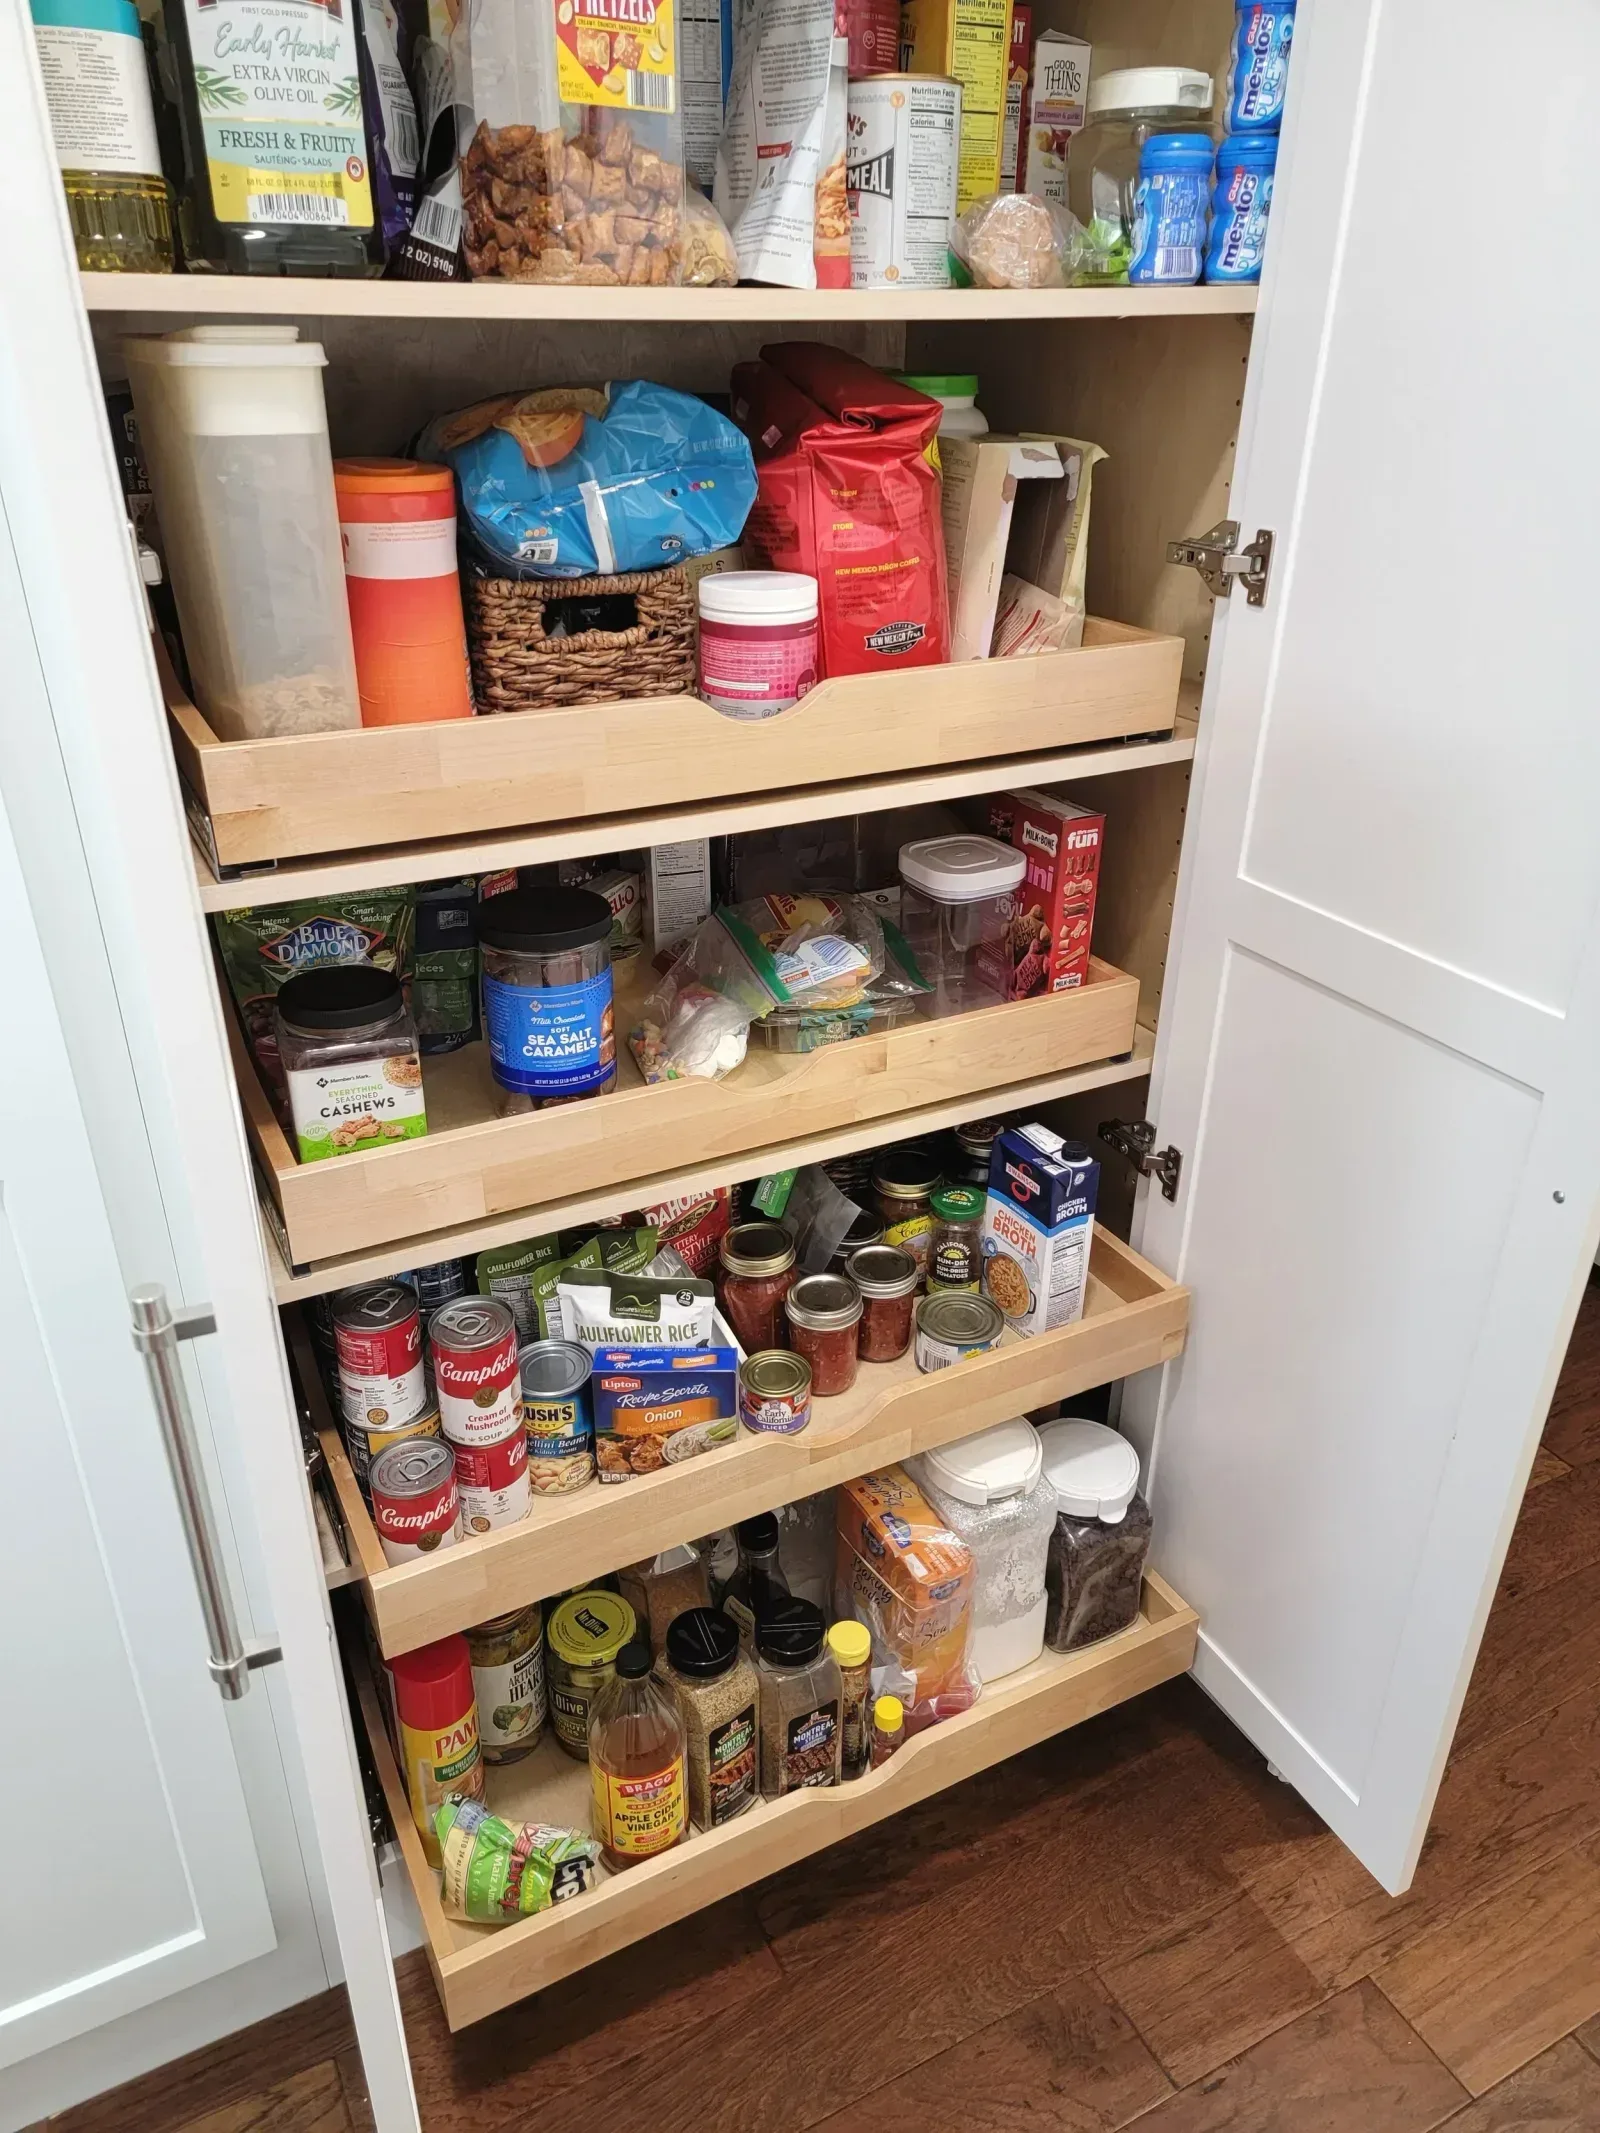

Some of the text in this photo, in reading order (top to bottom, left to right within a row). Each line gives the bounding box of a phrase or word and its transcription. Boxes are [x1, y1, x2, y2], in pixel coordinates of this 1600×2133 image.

[988, 1, 1006, 10] Facts
[214, 21, 272, 61] Early
[955, 30, 1004, 41] Calories 140
[1054, 60, 1075, 71] GOOD
[1243, 15, 1275, 118] mentos
[233, 65, 331, 85] EXTRA VIRGIN
[1044, 65, 1081, 92] THINS
[254, 87, 318, 104] OLIVE OIL
[911, 87, 956, 98] Nutrition Facts
[1007, 104, 1020, 114] 150
[910, 118, 954, 128] Calories 140
[218, 130, 357, 154] FRESH & FRUITY
[301, 156, 332, 167] SALADS
[848, 155, 891, 195] MEAL
[1045, 187, 1061, 197] real
[271, 212, 299, 221] 70404
[303, 212, 332, 222] 00864
[1222, 174, 1259, 269] mentos
[416, 249, 431, 268] OZ)
[432, 256, 454, 276] 510g
[835, 567, 850, 575] NEW
[851, 566, 877, 574] MEXICO
[879, 562, 898, 572] PIÑON
[870, 631, 907, 647] NEW MEXICO
[1067, 831, 1098, 850] fun
[1027, 857, 1054, 893] ini
[609, 885, 635, 917] ELL-O
[226, 910, 252, 923] Pack
[352, 906, 374, 916] Smart
[360, 913, 393, 923] Snacking!
[262, 916, 290, 927] Intense
[256, 926, 279, 936] Taste!
[301, 925, 347, 945] BLUE
[278, 934, 371, 962] DIAMOND
[416, 963, 445, 974] ieces
[531, 1013, 586, 1025] Milk Chocolate
[528, 1027, 592, 1046] SEA SALT
[550, 1026, 571, 1034] SOFT
[522, 1037, 598, 1057] CARAMELS
[330, 1076, 355, 1084] Member's
[328, 1083, 384, 1098] EVERYTHING
[335, 1092, 379, 1104] SEASONED
[320, 1097, 396, 1118] CASHEWS
[305, 1126, 328, 1136] 100%
[1007, 1163, 1040, 1195] SWANSON
[645, 1188, 716, 1228] DAHOAN
[1057, 1196, 1086, 1211] CHICKEN
[1056, 1204, 1087, 1223] BROTH
[997, 1209, 1036, 1243] CHICKEN
[993, 1215, 1037, 1258] BROTH
[937, 1241, 971, 1256] CALIFORNIA
[487, 1246, 552, 1274] CAULIFLOWER RICE
[580, 1254, 596, 1268] RICE
[936, 1265, 969, 1274] SUN-DRIED
[936, 1270, 969, 1280] TOMATOES
[681, 1291, 691, 1300] 25
[669, 1322, 698, 1343] RICE
[438, 1339, 517, 1385] Campbell
[608, 1354, 630, 1362] Lipton
[605, 1381, 639, 1392] Lipton
[617, 1383, 710, 1408] Recipe Secrets
[468, 1406, 507, 1422] Cream of
[644, 1408, 683, 1424] Onion
[764, 1409, 787, 1417] Early
[465, 1414, 511, 1431] Mushroom
[478, 1431, 503, 1441] SOUP
[558, 1435, 586, 1448] Beans
[559, 1446, 577, 1454] Beans
[850, 1554, 893, 1604] Baking
[853, 1574, 881, 1608] Soda
[584, 1616, 605, 1638] Olive
[508, 1656, 541, 1688] ARTICHO
[509, 1671, 542, 1703] HEAR
[555, 1694, 584, 1715] Olive
[435, 1714, 477, 1759] PAM
[714, 1724, 753, 1755] MONTREAL
[793, 1719, 835, 1744] MONTREAL
[805, 1731, 823, 1744] STEAK
[722, 1737, 747, 1756] CHICKEN
[624, 1773, 672, 1793] BRAGG
[615, 1795, 682, 1823] APPLE CIDER
[632, 1795, 670, 1809] ORGANIC
[627, 1811, 674, 1832] VINEGAR
[491, 1854, 502, 1884] Maiz
